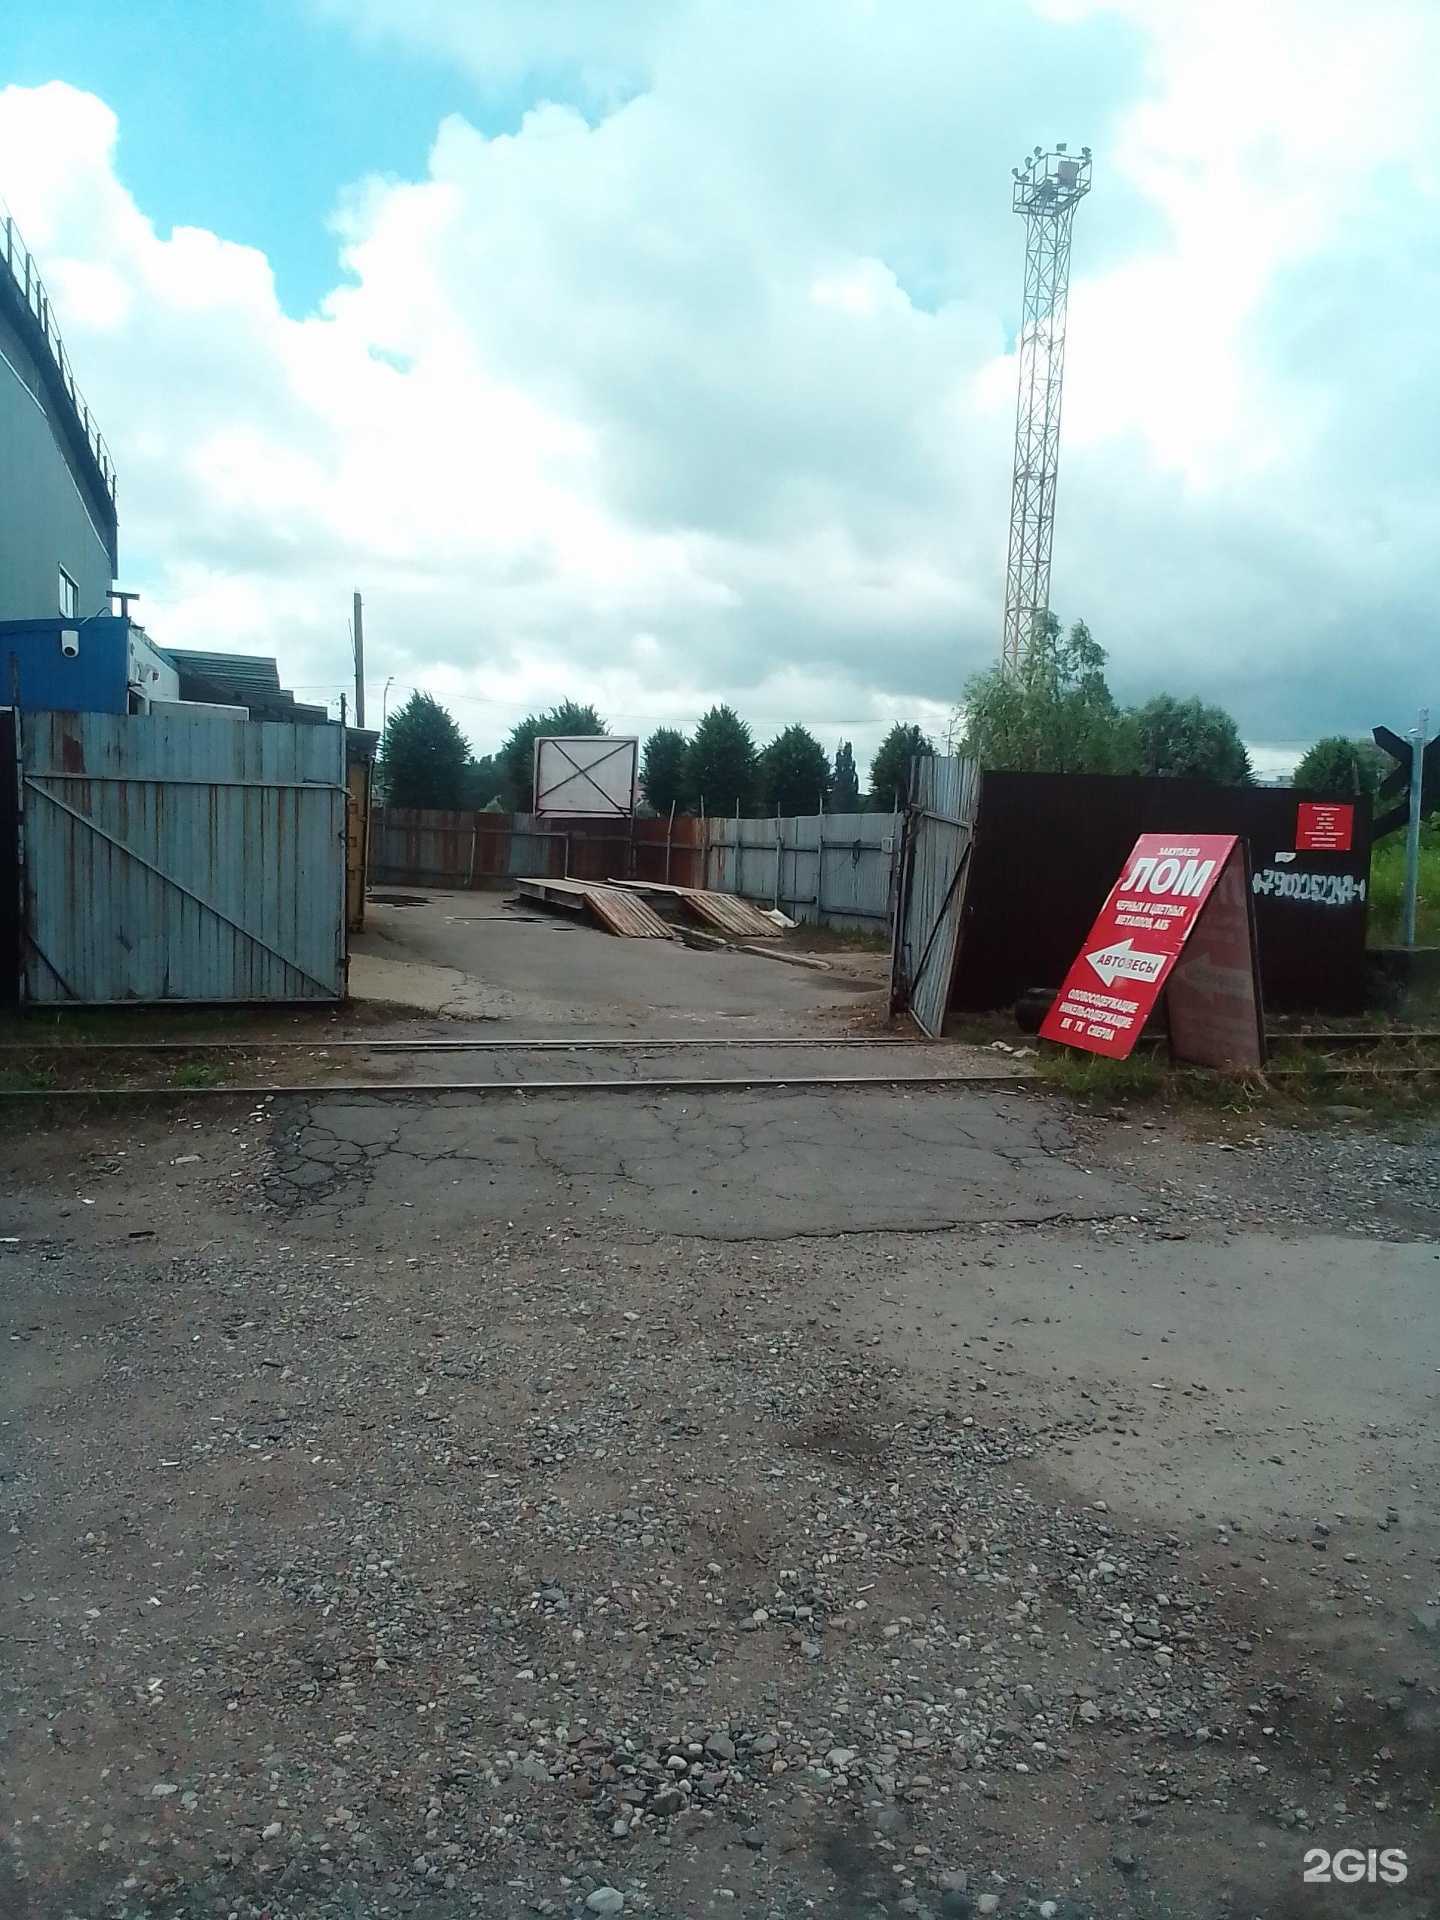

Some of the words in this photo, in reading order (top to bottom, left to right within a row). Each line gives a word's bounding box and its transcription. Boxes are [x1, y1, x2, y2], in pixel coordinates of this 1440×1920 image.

[1120, 857, 1216, 897] ЛОМ
[1116, 900, 1144, 912] ЧЕРНЫХ
[1143, 902, 1151, 913] И
[1150, 903, 1187, 917] ЦВЕТНЫХ
[1096, 954, 1158, 974] АВТОВЕСЫ
